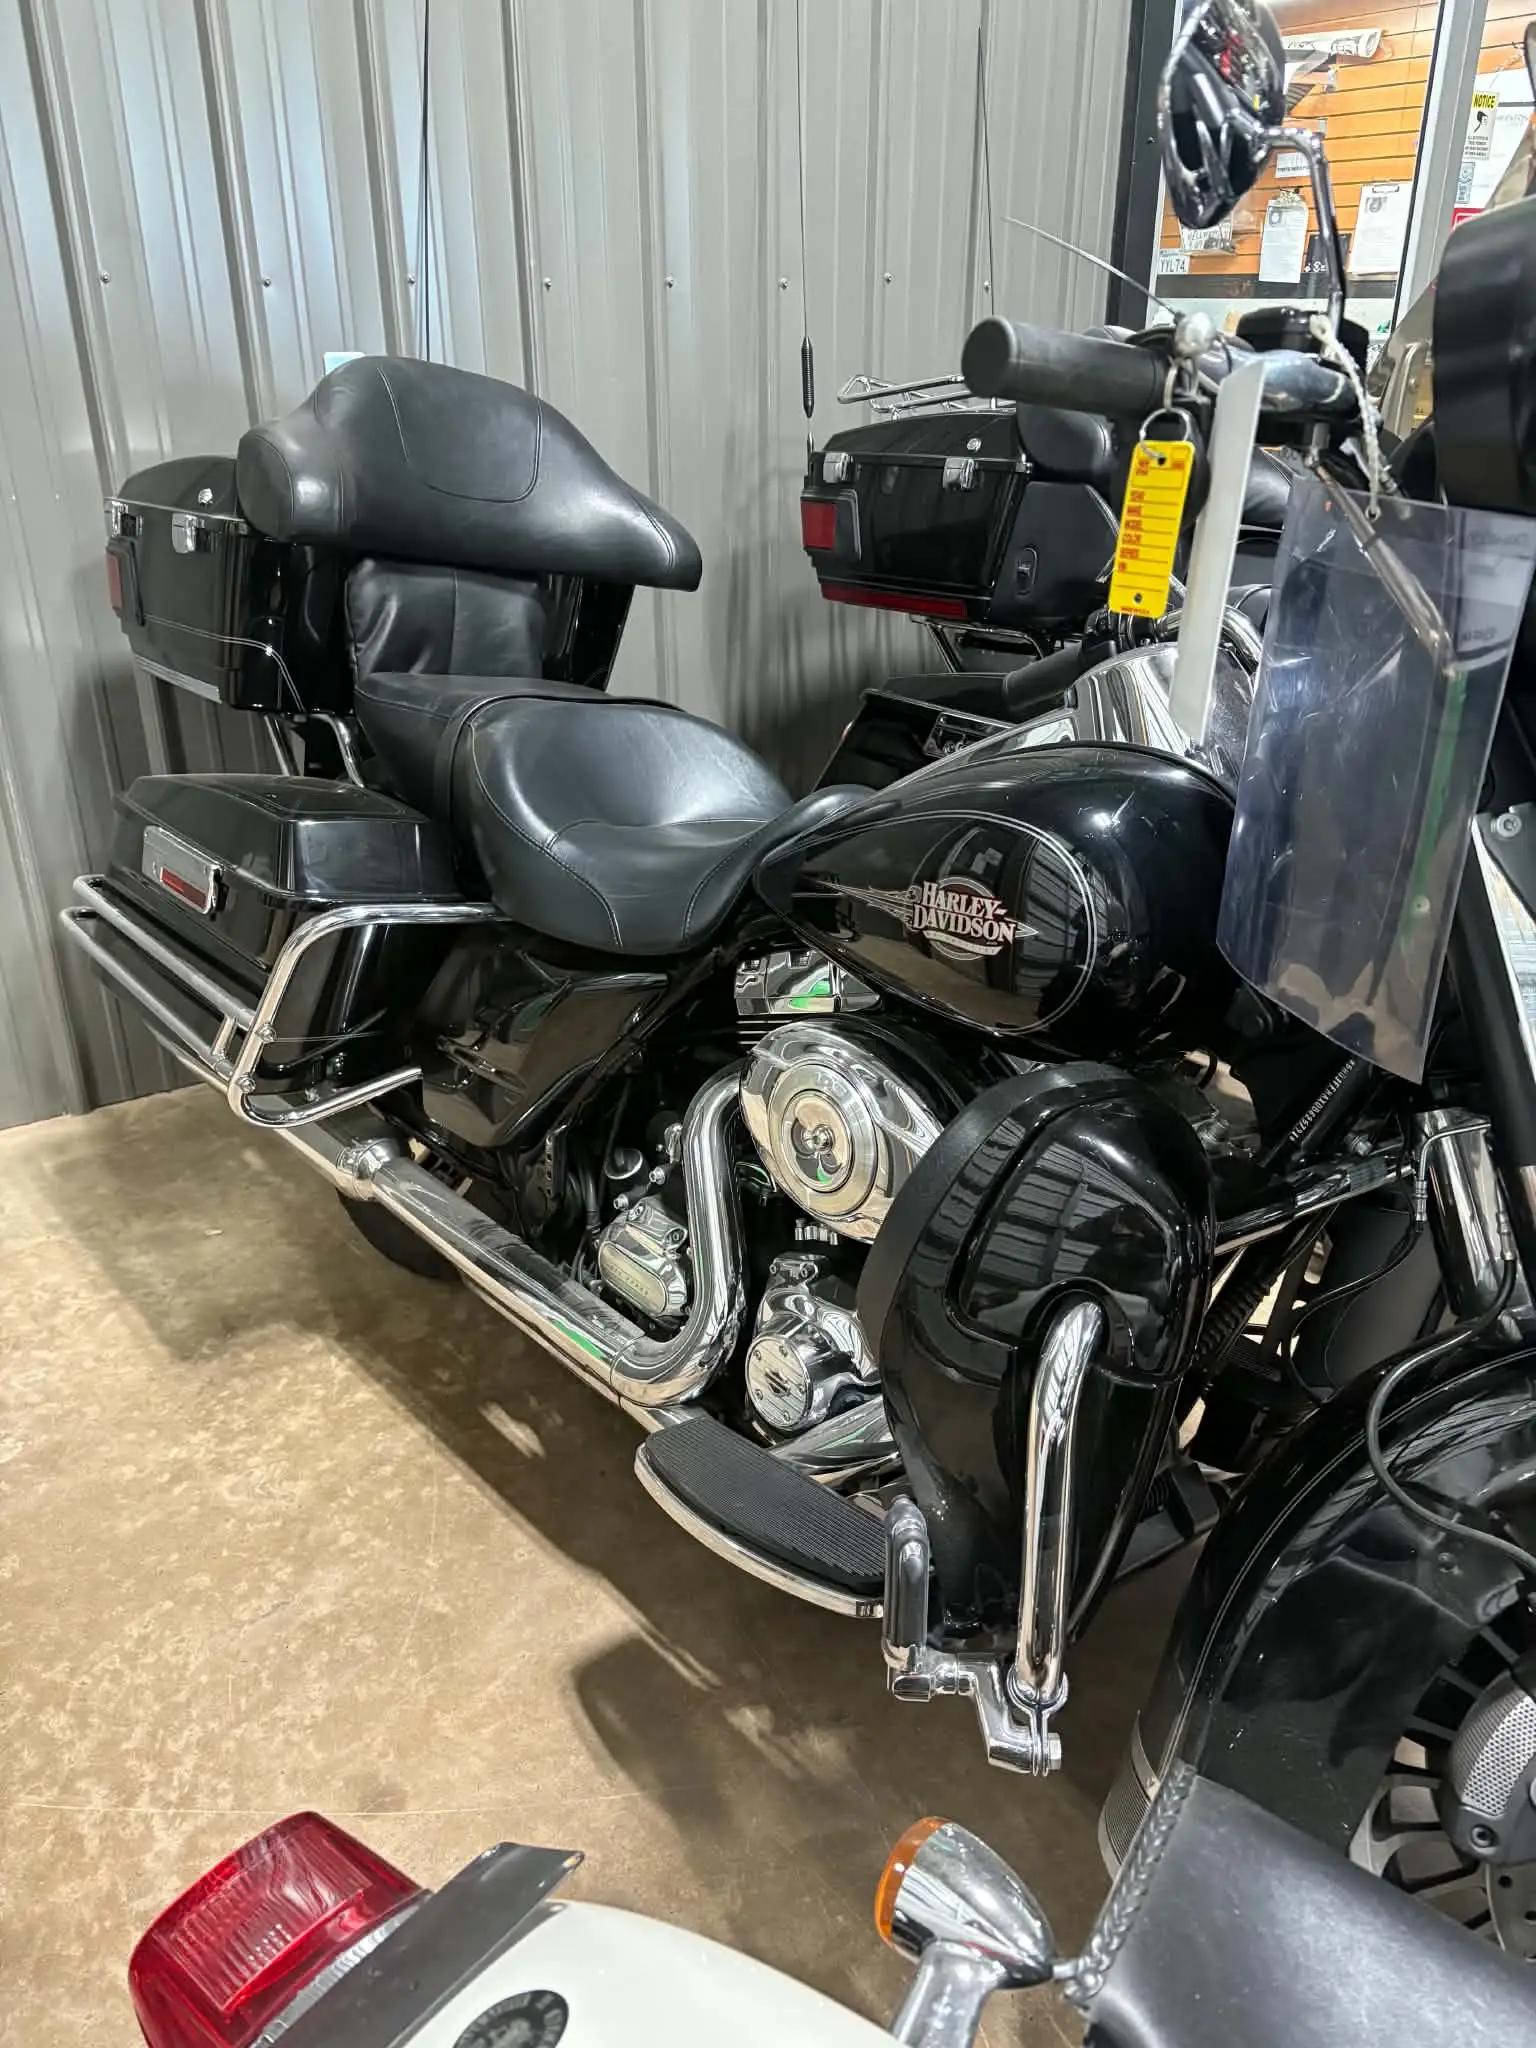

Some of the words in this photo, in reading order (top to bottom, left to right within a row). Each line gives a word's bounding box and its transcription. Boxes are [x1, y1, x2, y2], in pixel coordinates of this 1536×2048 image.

[1473, 94, 1496, 109] NOTICE
[923, 880, 1008, 920] HARLEY-
[912, 904, 1017, 944] DAVIDSON
